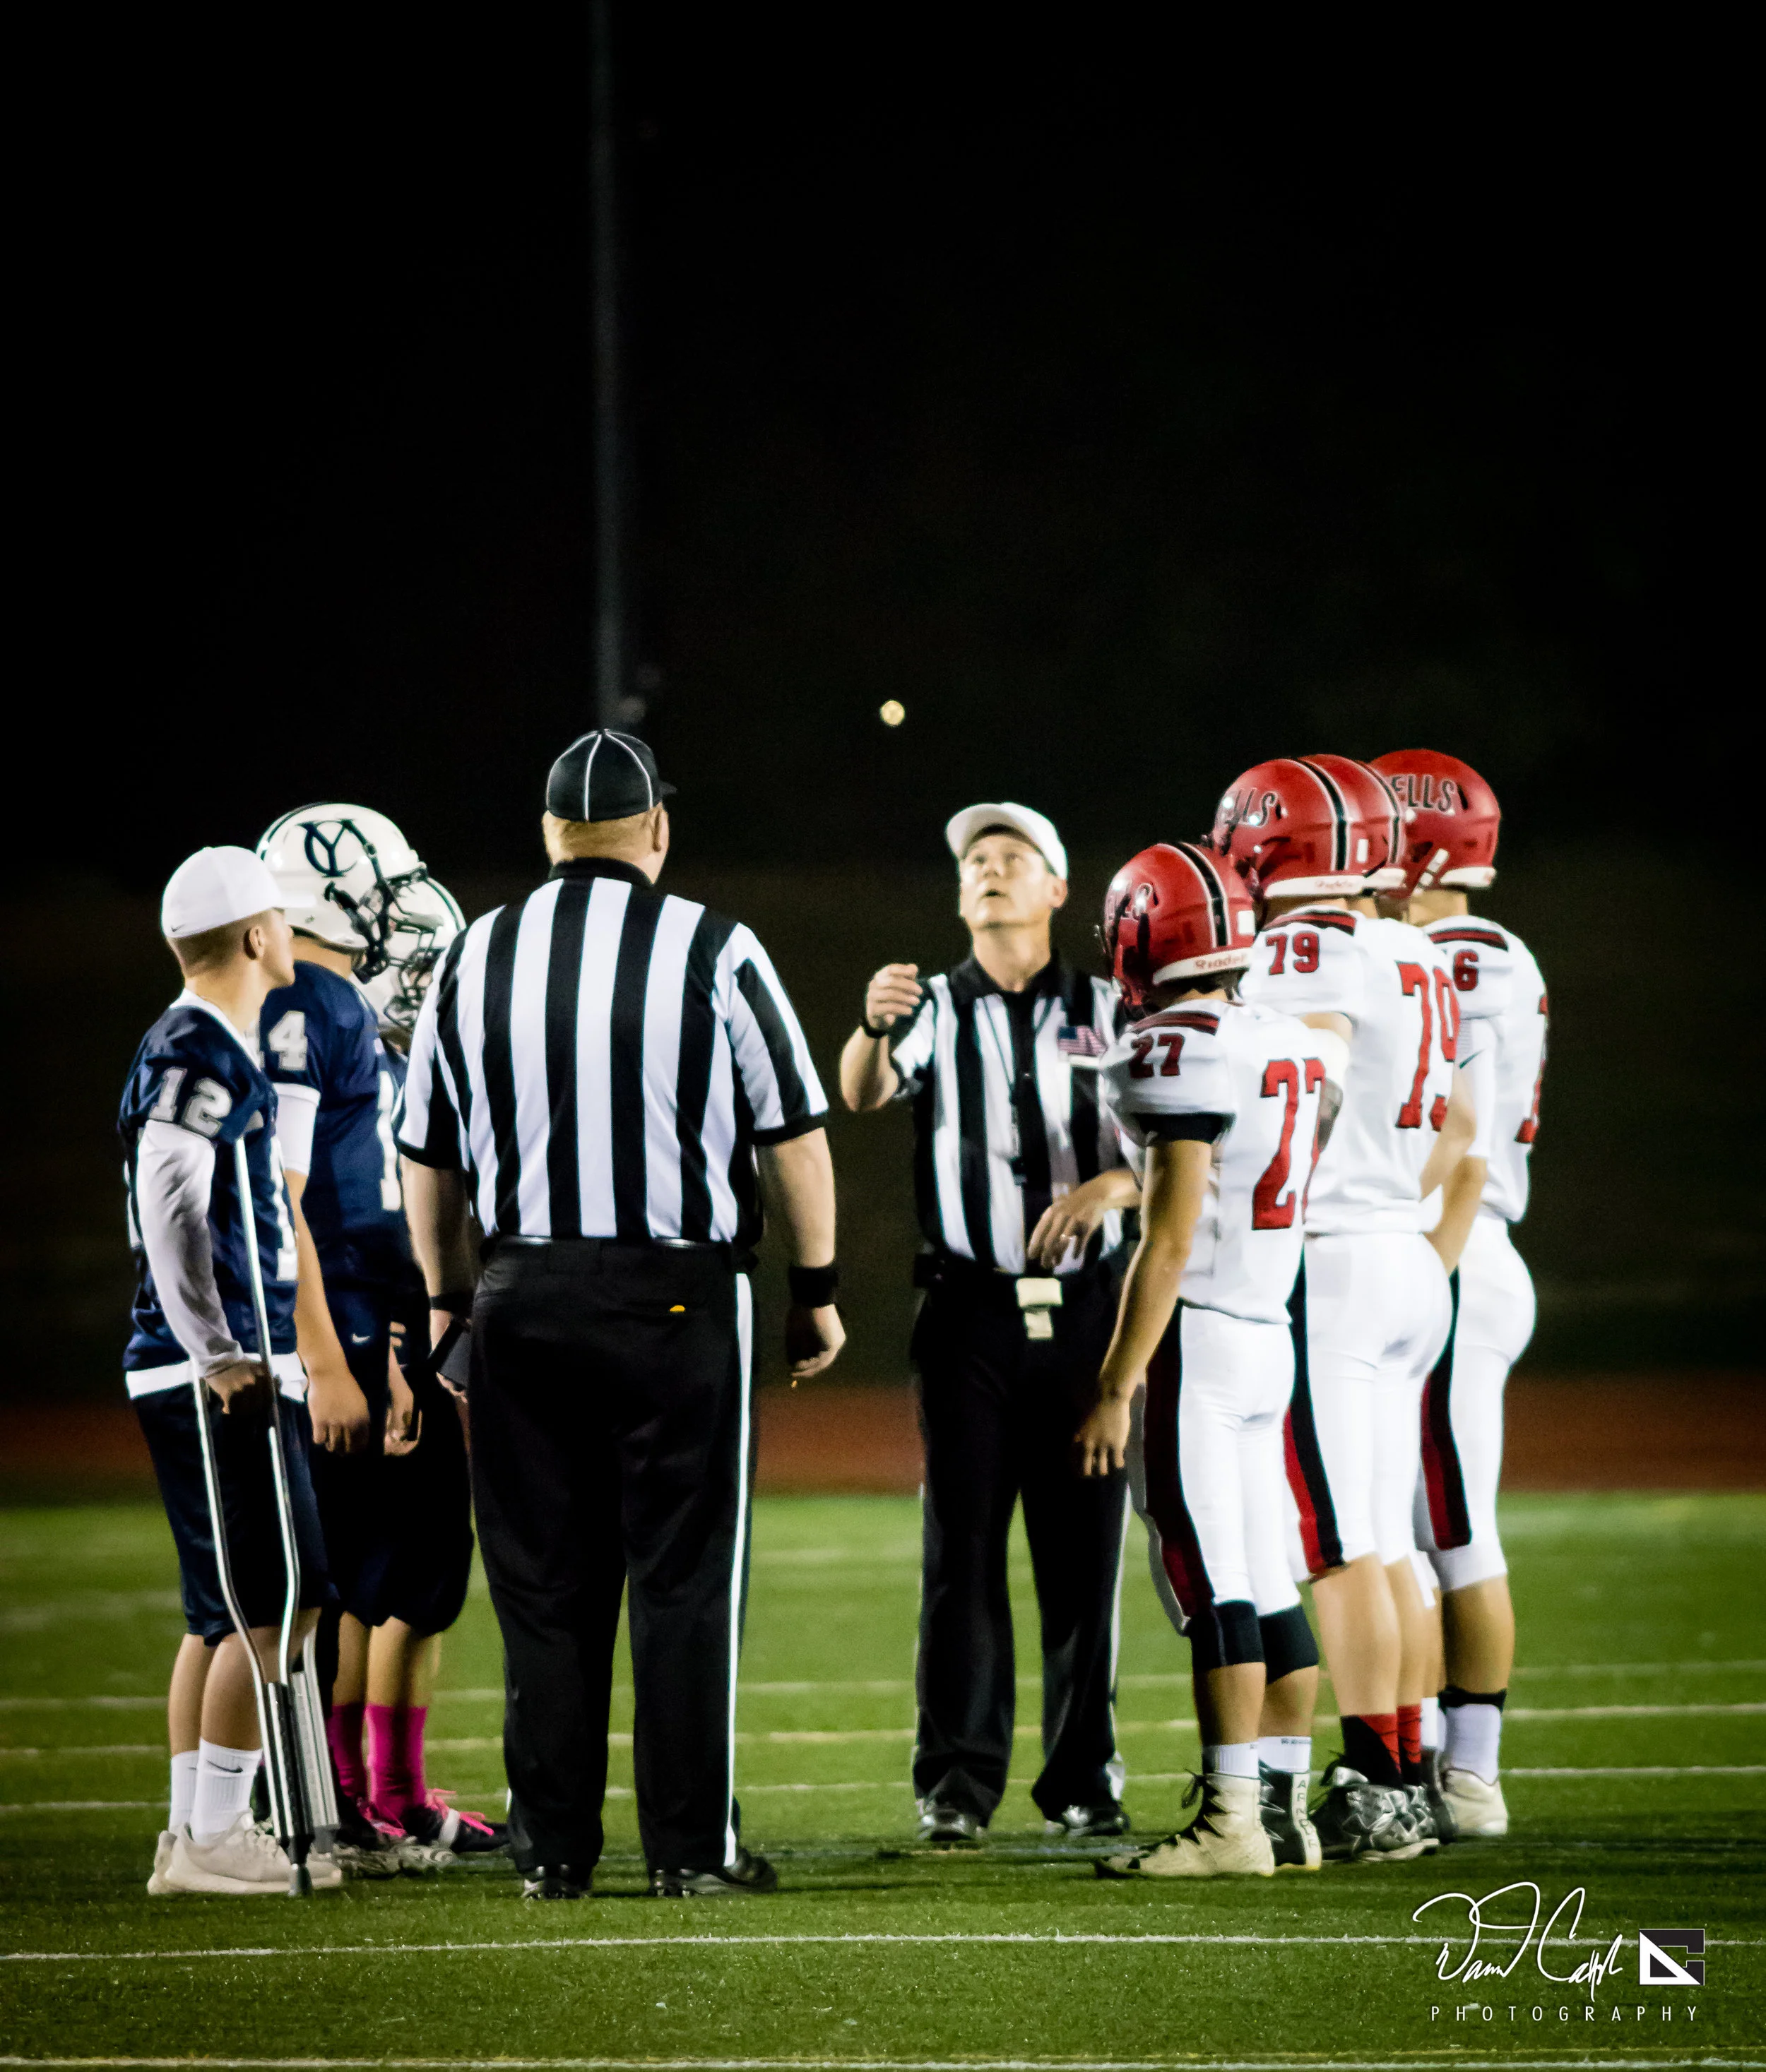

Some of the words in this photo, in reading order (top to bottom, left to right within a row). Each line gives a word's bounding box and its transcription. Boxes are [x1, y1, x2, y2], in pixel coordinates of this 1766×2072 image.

[1265, 931, 1320, 975] 79
[1443, 949, 1479, 992] 6
[1129, 1032, 1185, 1078] 27
[148, 1067, 232, 1138] 12
[1251, 1057, 1326, 1231] 27
